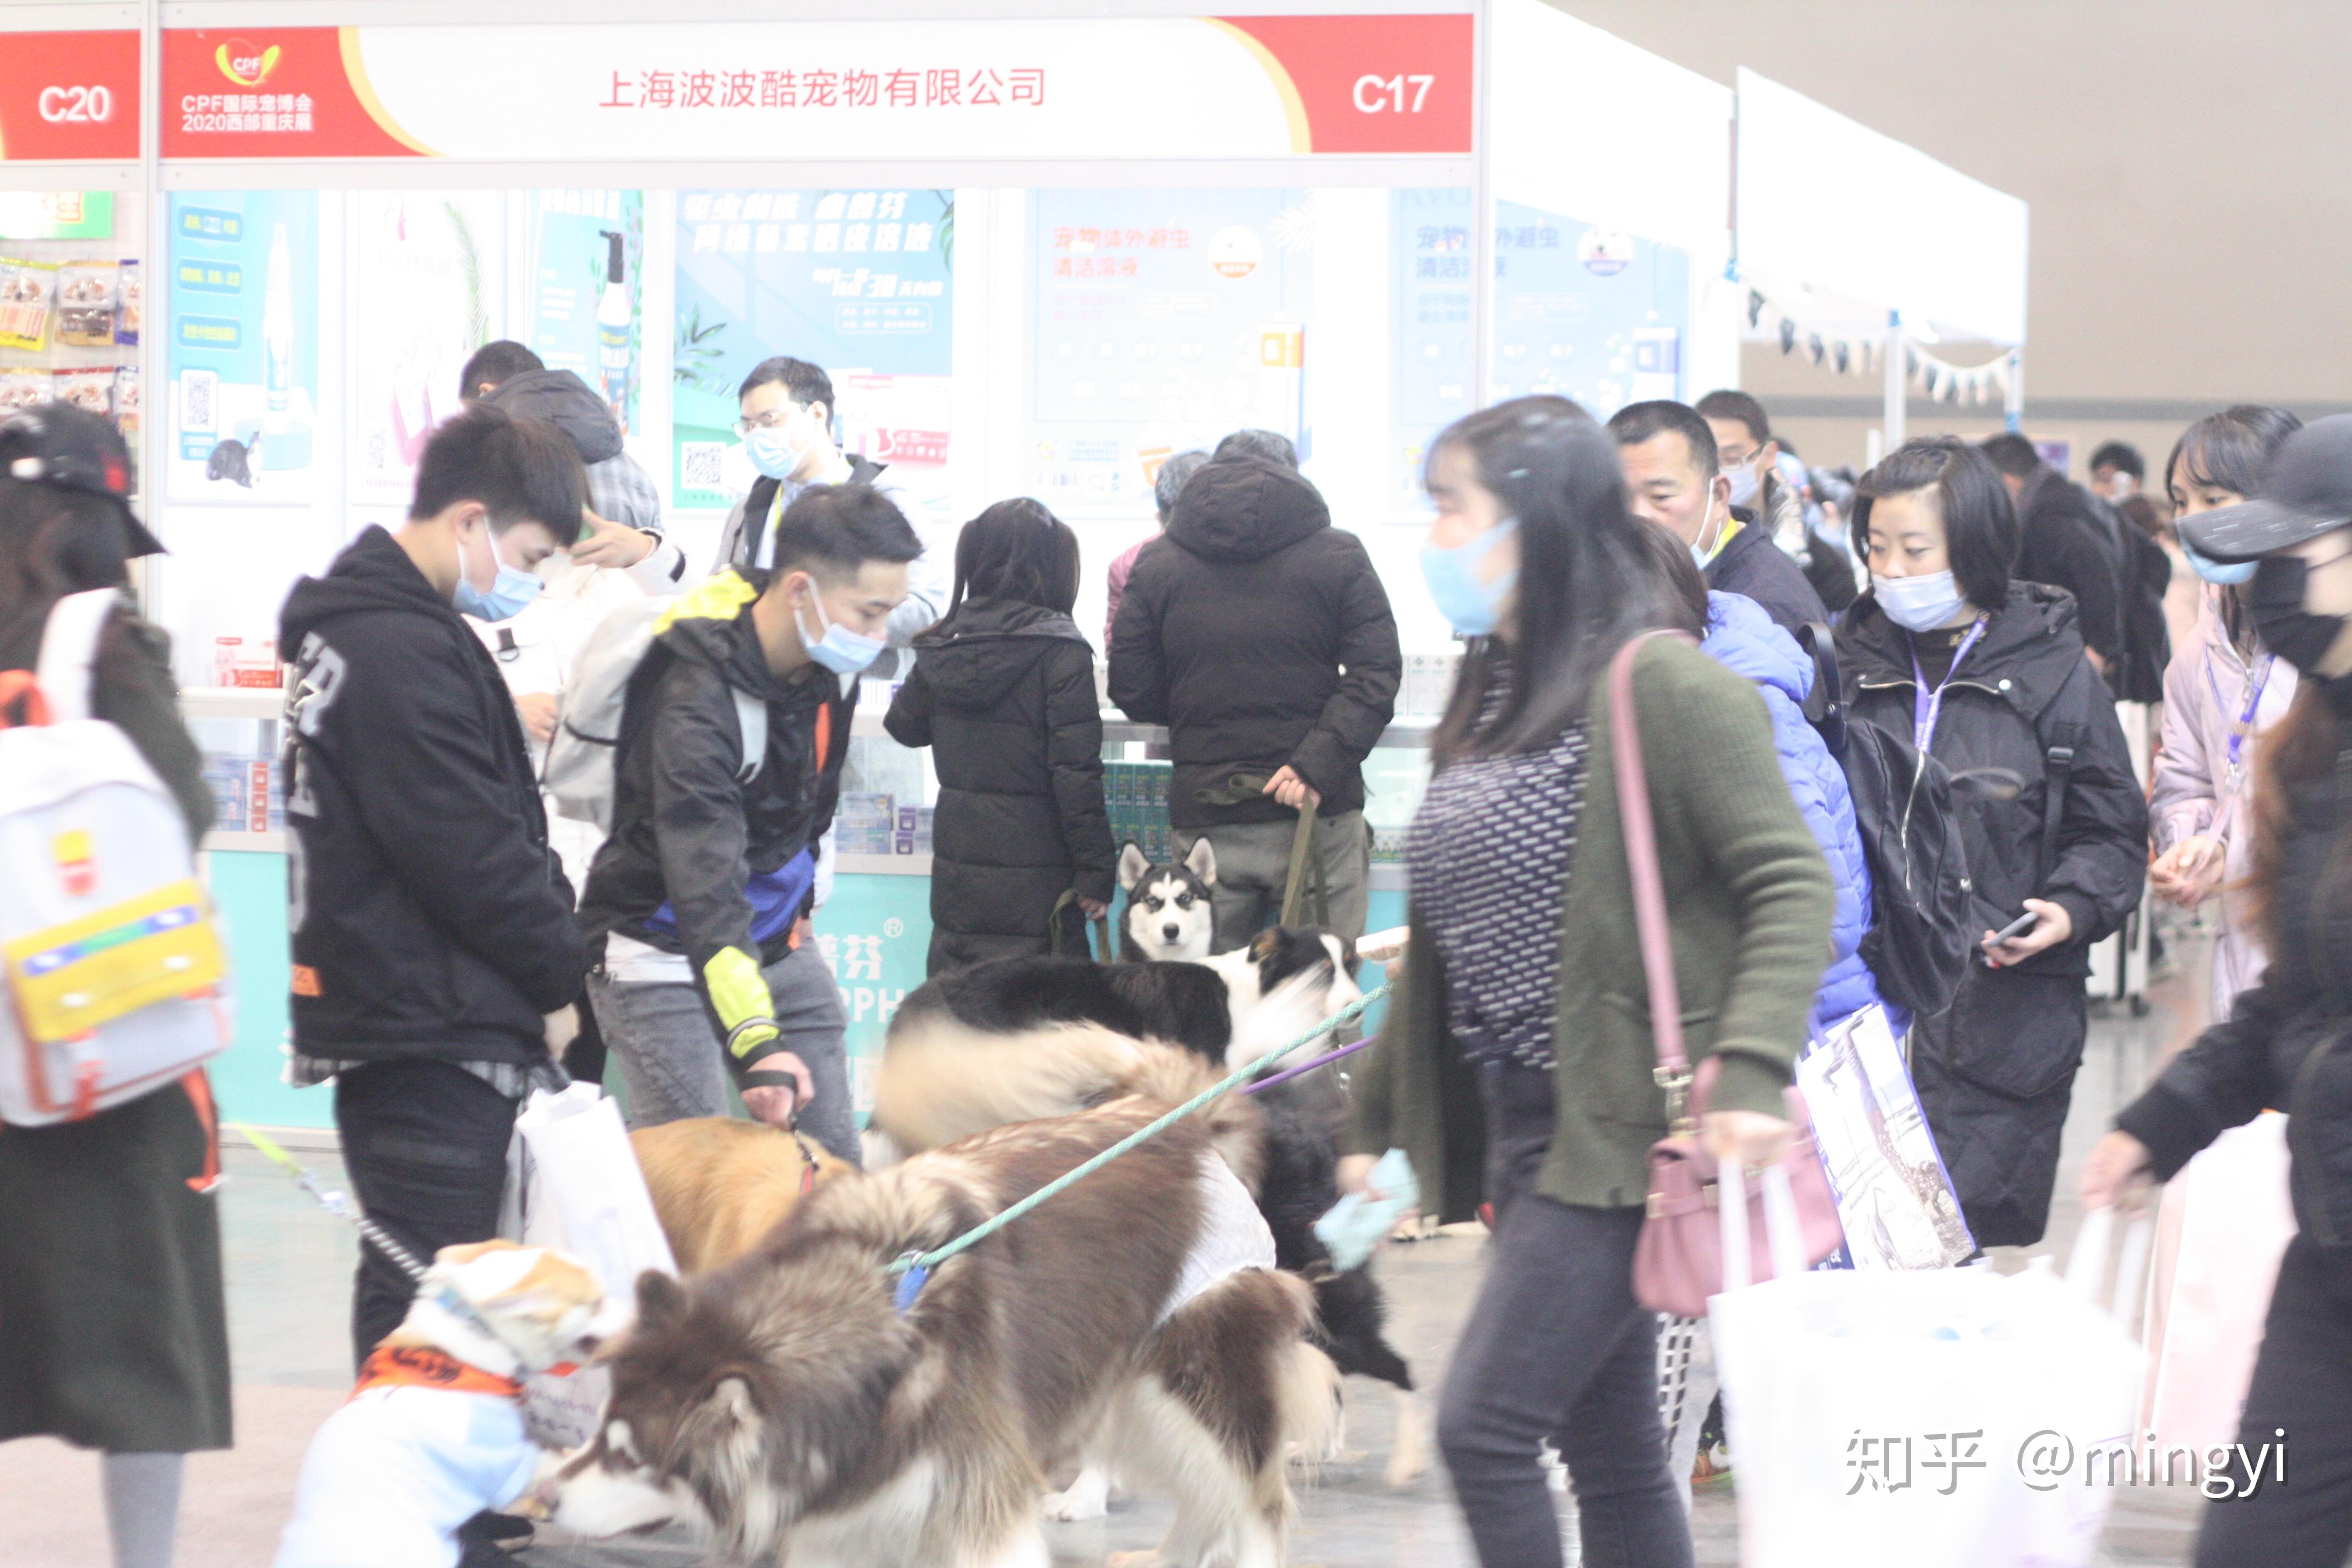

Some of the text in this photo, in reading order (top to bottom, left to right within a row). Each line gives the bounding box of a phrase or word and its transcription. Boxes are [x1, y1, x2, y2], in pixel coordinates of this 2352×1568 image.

[233, 57, 261, 71] CPF
[599, 68, 1044, 108] 上海波波酷宠物有限公司
[1353, 74, 1435, 113] C17
[39, 85, 110, 122] C20
[182, 94, 312, 112] CPF国际宠博会
[182, 113, 312, 132] 2020西部重庆展
[1416, 225, 1559, 249] 宠物外避虫
[1052, 256, 1139, 278] 清洁溶液
